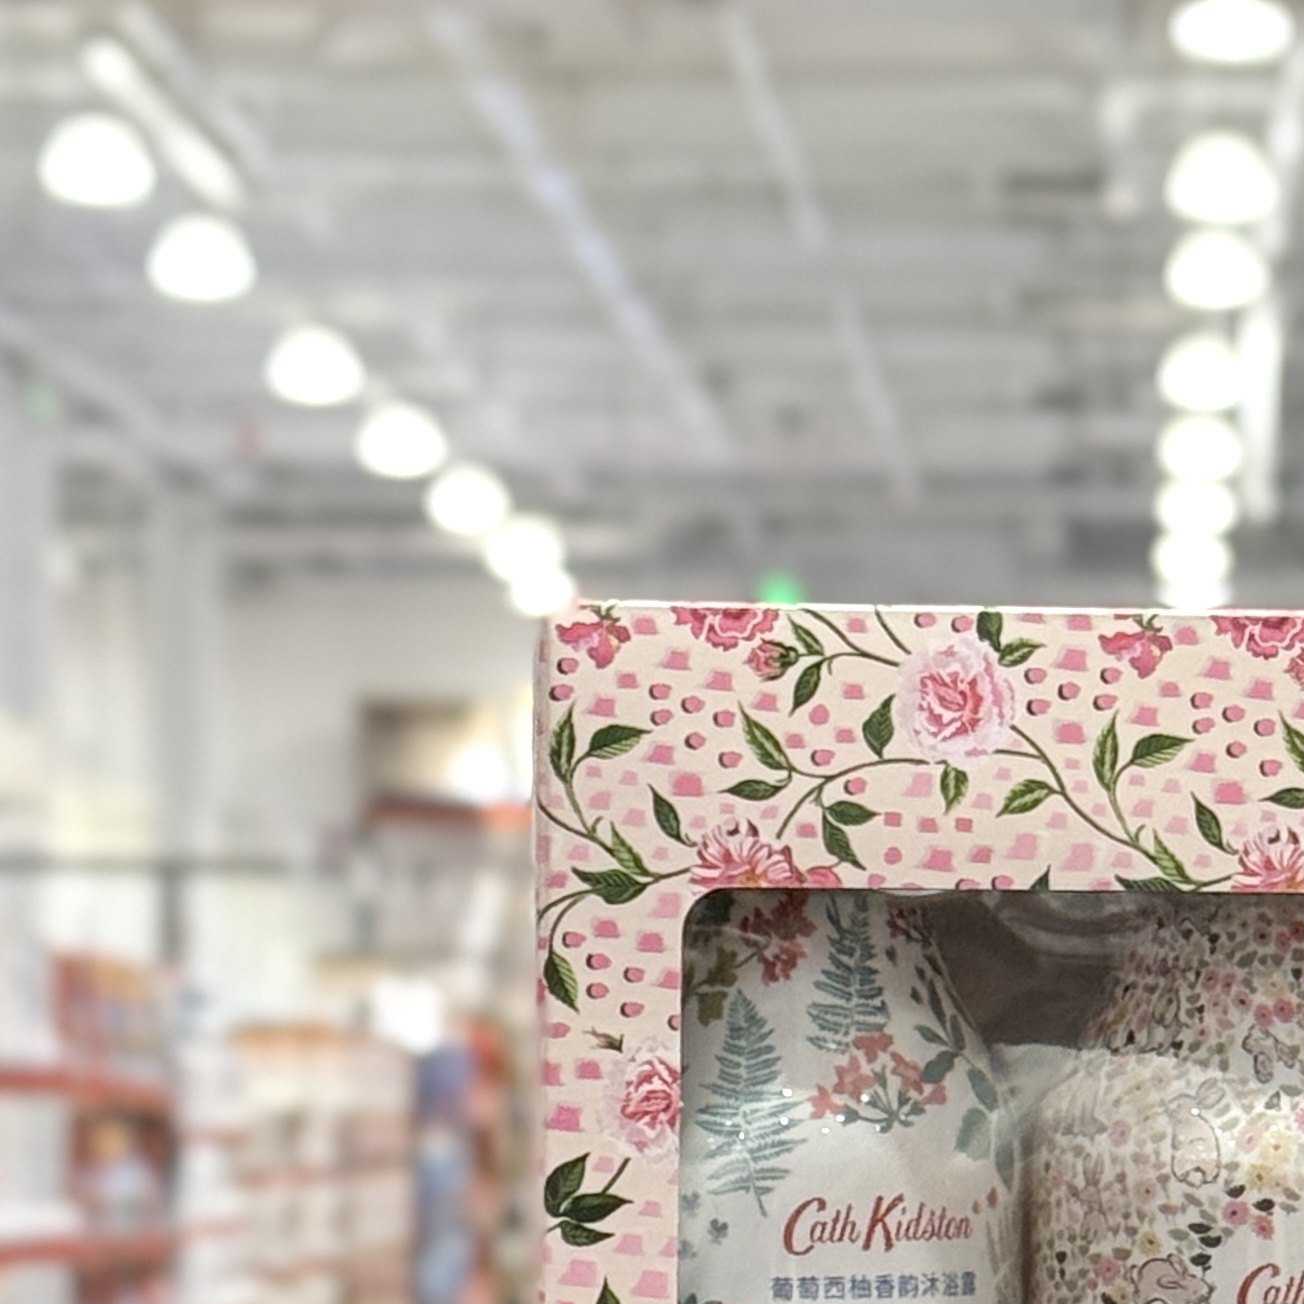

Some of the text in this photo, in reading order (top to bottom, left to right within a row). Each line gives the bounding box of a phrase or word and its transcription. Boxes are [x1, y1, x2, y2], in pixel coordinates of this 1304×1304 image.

[783, 1193, 974, 1256] Cath Kidston
[770, 1271, 977, 1302] 葡萄西柚香韵沐浴露
